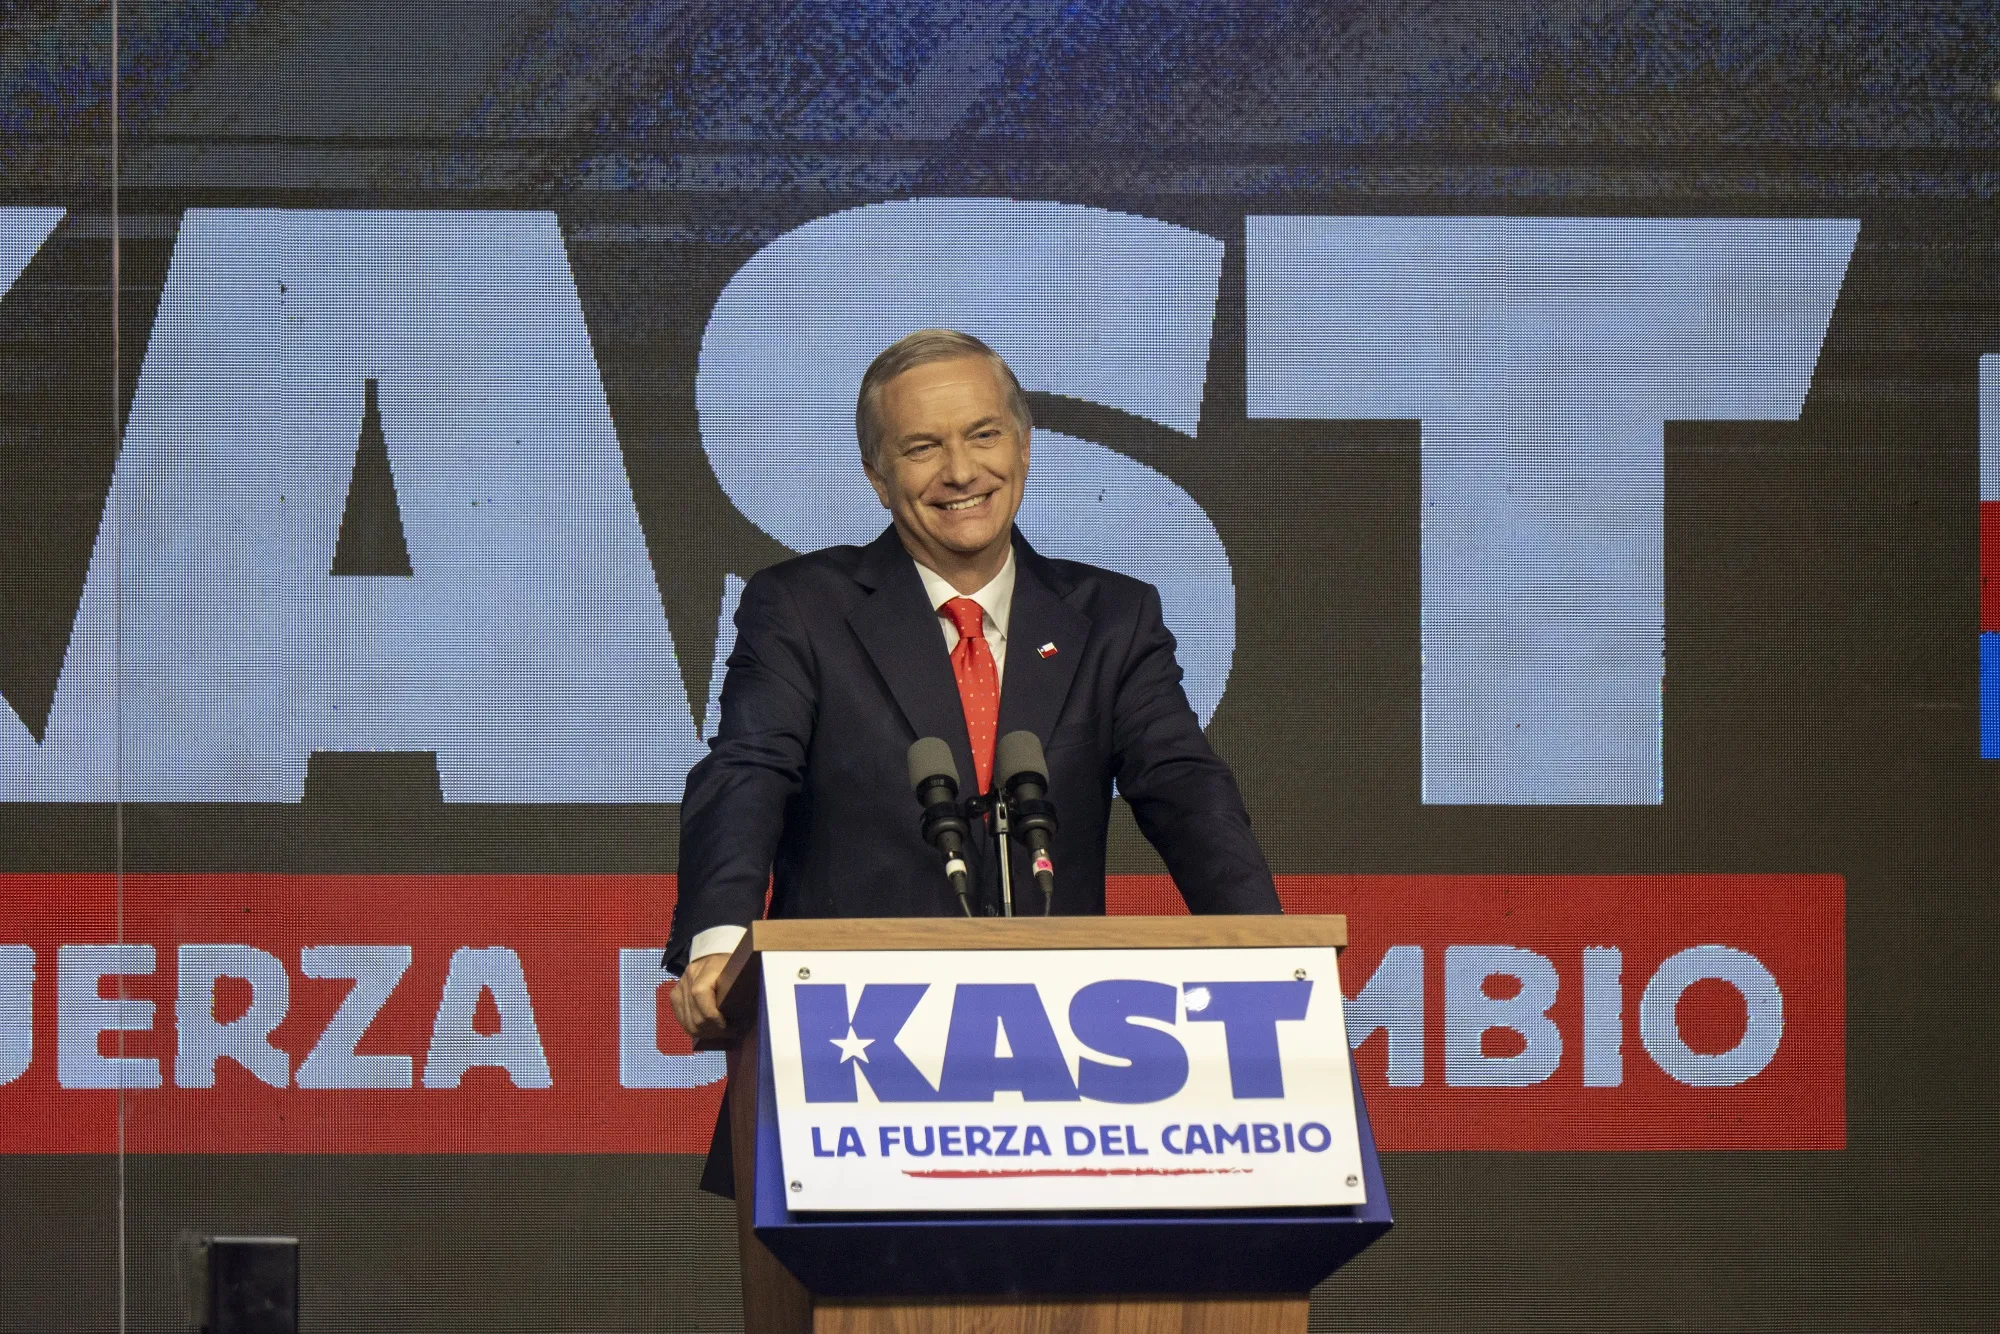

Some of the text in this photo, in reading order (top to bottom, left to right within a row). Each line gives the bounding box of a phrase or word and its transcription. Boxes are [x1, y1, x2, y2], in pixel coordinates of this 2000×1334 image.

[0, 196, 1861, 806] AST
[795, 980, 1313, 1104] KAST
[811, 1122, 1332, 1158] LA FUERZA DEL CAMBIO
